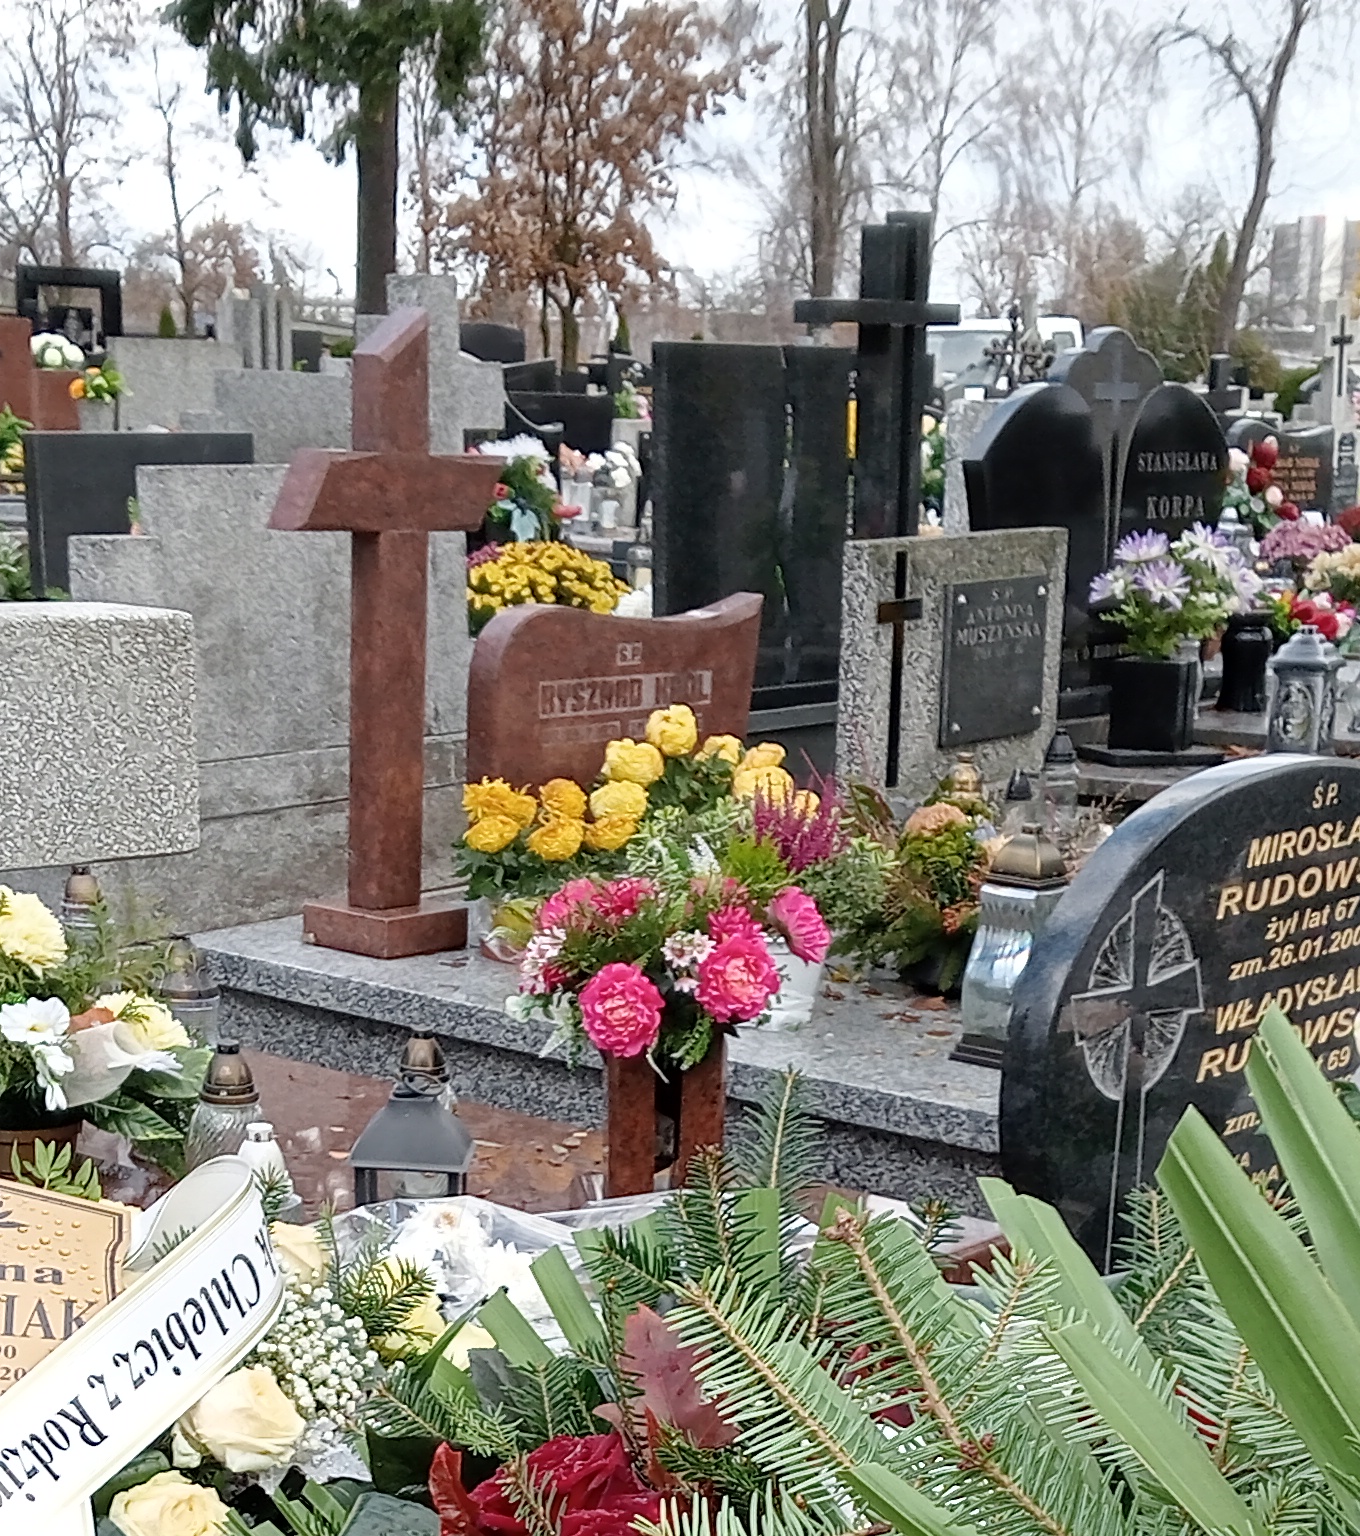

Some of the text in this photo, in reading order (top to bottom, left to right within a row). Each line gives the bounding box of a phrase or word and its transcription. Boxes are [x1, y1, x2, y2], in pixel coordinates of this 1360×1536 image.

[1146, 496, 1204, 519] KORPA
[1265, 895, 1360, 943] żył lat 67
[1326, 1046, 1351, 1071] 69
[113, 1254, 262, 1390] Chlebicz
[87, 1374, 124, 1411] z
